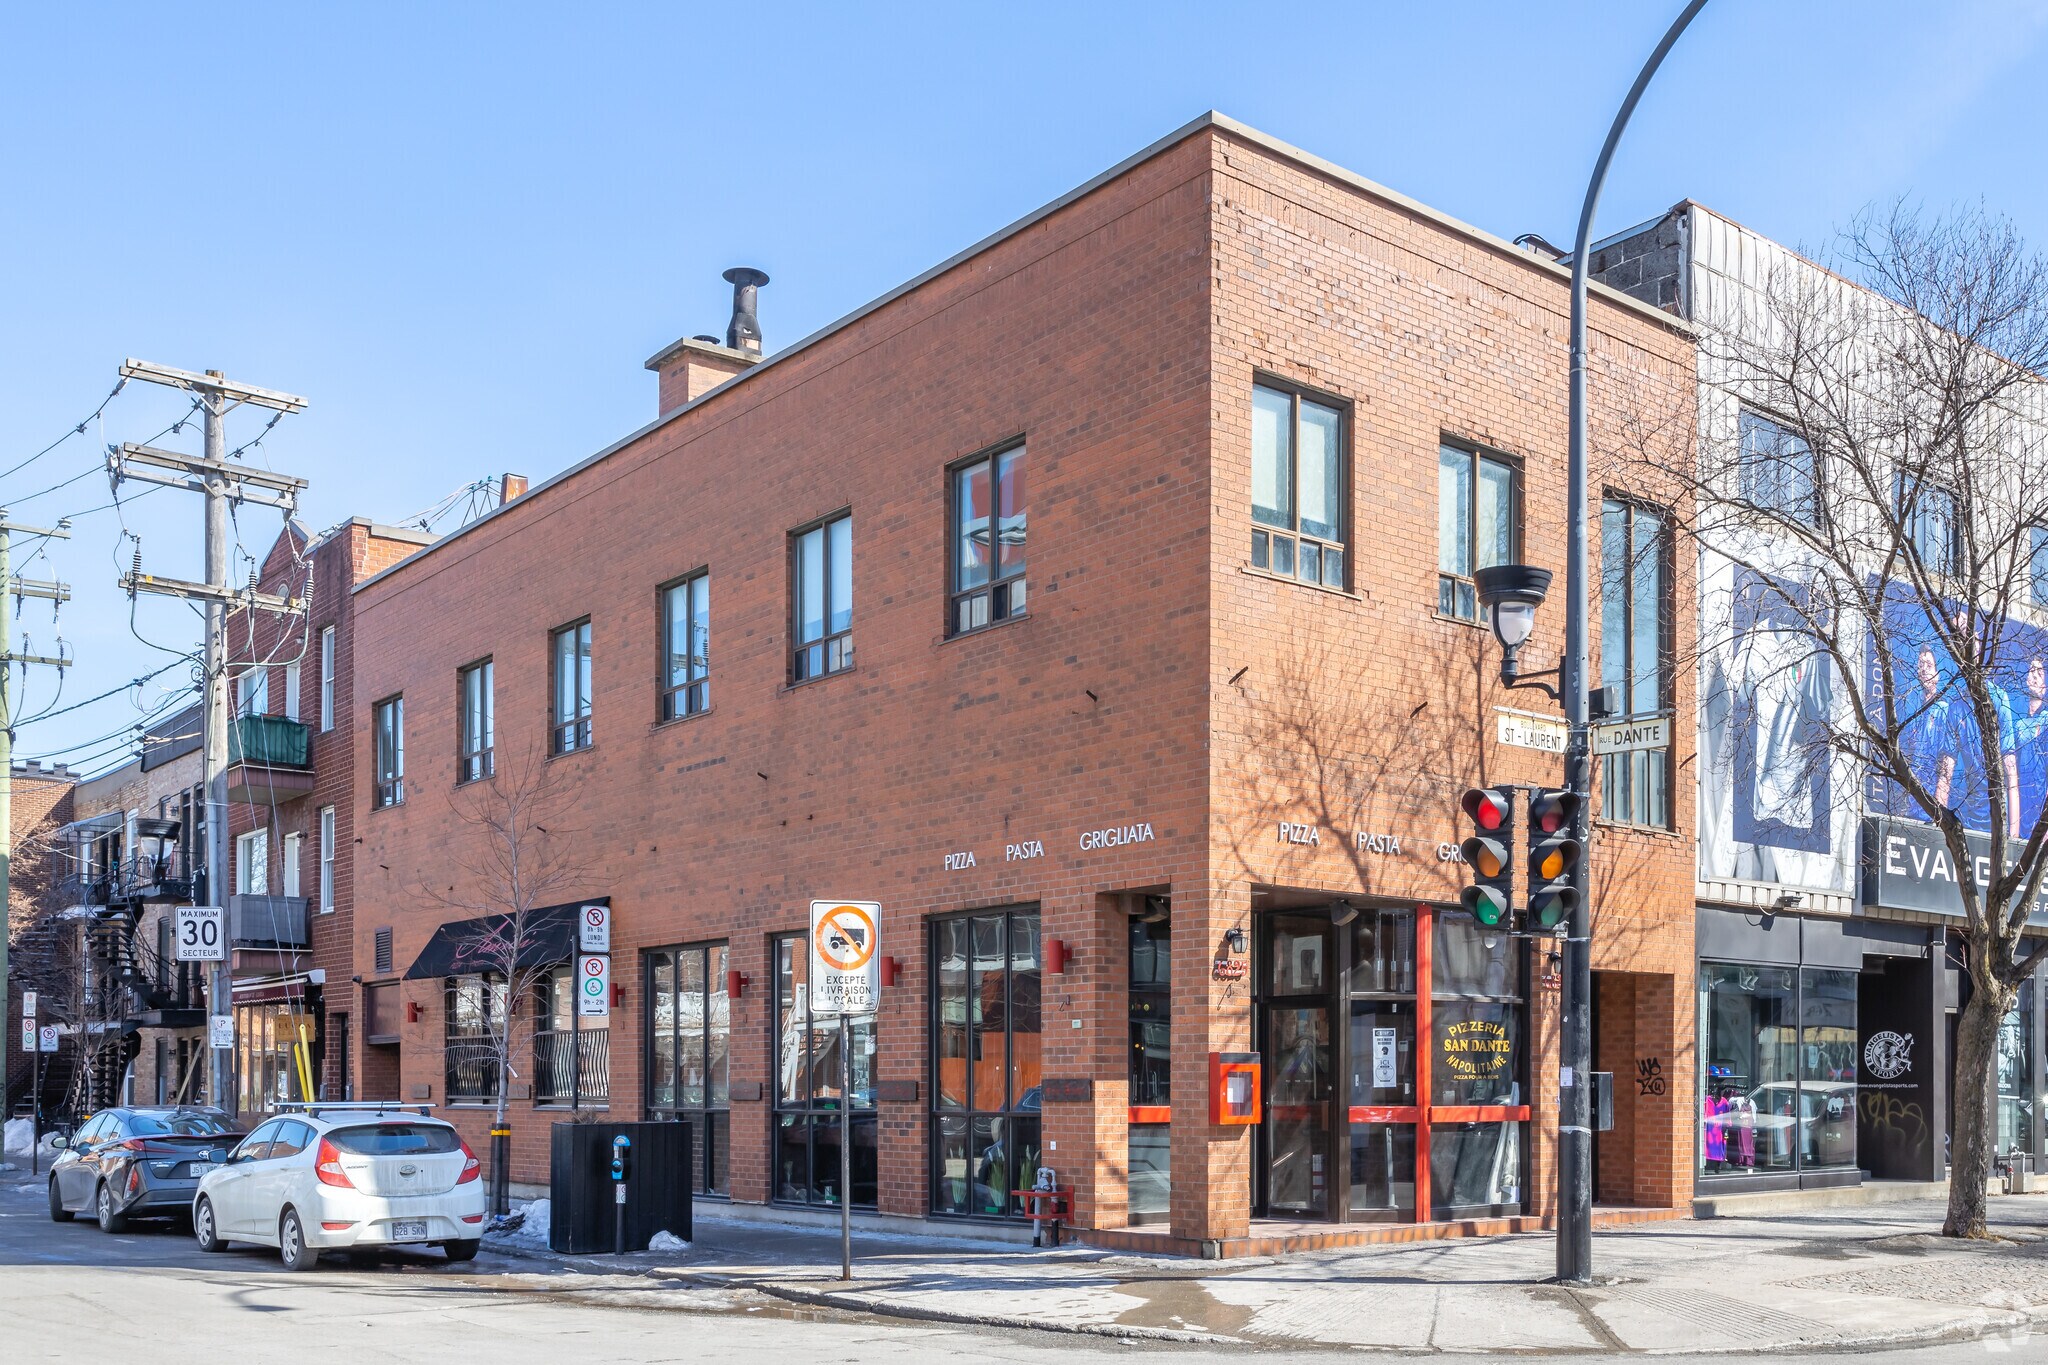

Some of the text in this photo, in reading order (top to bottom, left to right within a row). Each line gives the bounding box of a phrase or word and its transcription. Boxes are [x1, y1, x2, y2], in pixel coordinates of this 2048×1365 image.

[1599, 726, 1660, 746] RUE DANTE
[944, 823, 1155, 871] PIZZA PASTA GRIGLIATA
[1278, 821, 1321, 846] PIZZA
[1357, 831, 1401, 856] PASTA
[180, 910, 219, 918] MAXIMUM
[182, 919, 218, 947] 30
[182, 949, 219, 957] SECTEUR
[826, 974, 866, 985] EXCEPTÉ
[1447, 1021, 1506, 1038] PIZZERIA
[1443, 1038, 1511, 1053] SAN DANTE
[1865, 1032, 1904, 1065] EVANGELISTA
[1445, 1054, 1507, 1074] NAPOLITAINE
[1873, 1065, 1905, 1078] SPORTS
